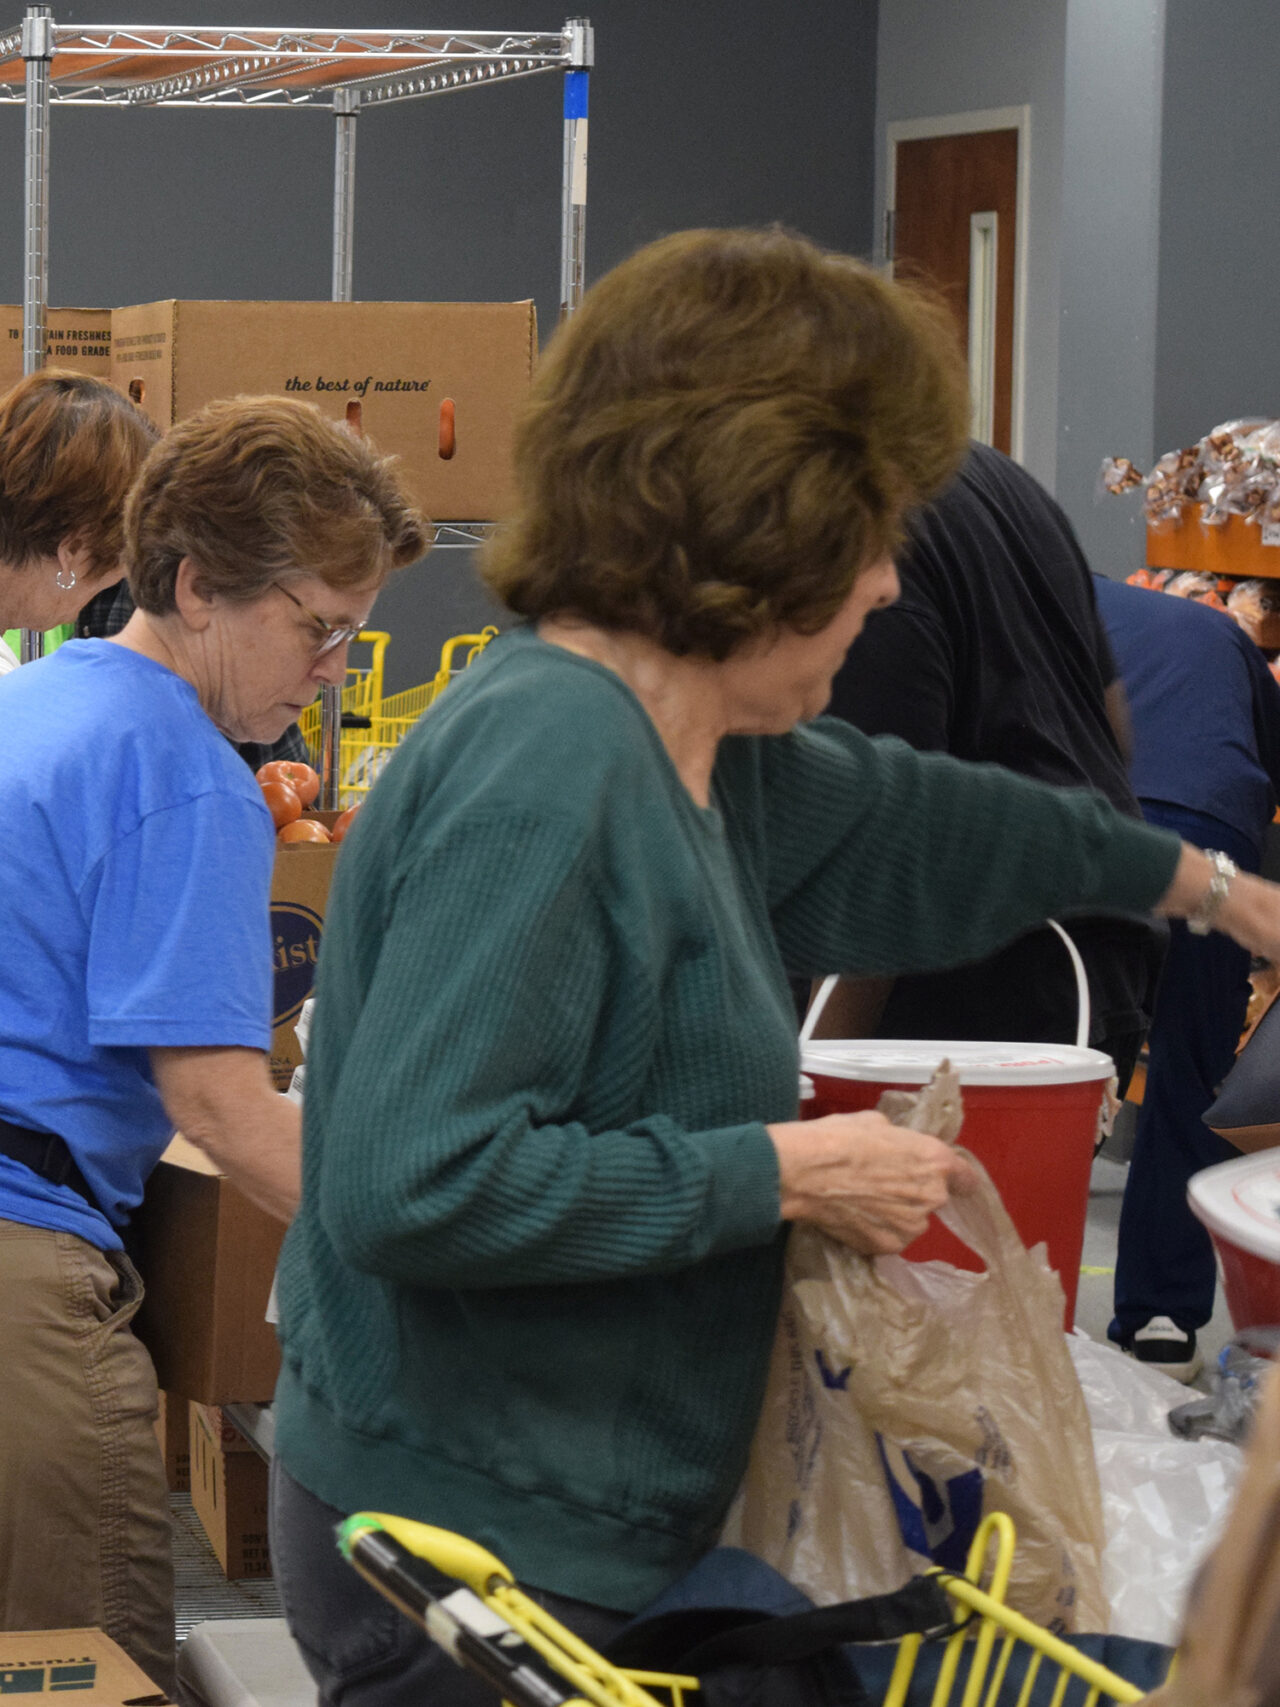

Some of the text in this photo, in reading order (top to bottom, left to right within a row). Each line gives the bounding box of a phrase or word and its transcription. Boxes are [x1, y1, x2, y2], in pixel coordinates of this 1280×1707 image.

[8, 328, 20, 339] TO
[56, 345, 78, 355] FOOD
[81, 346, 111, 357] GRADE
[285, 376, 431, 398] the best of nature
